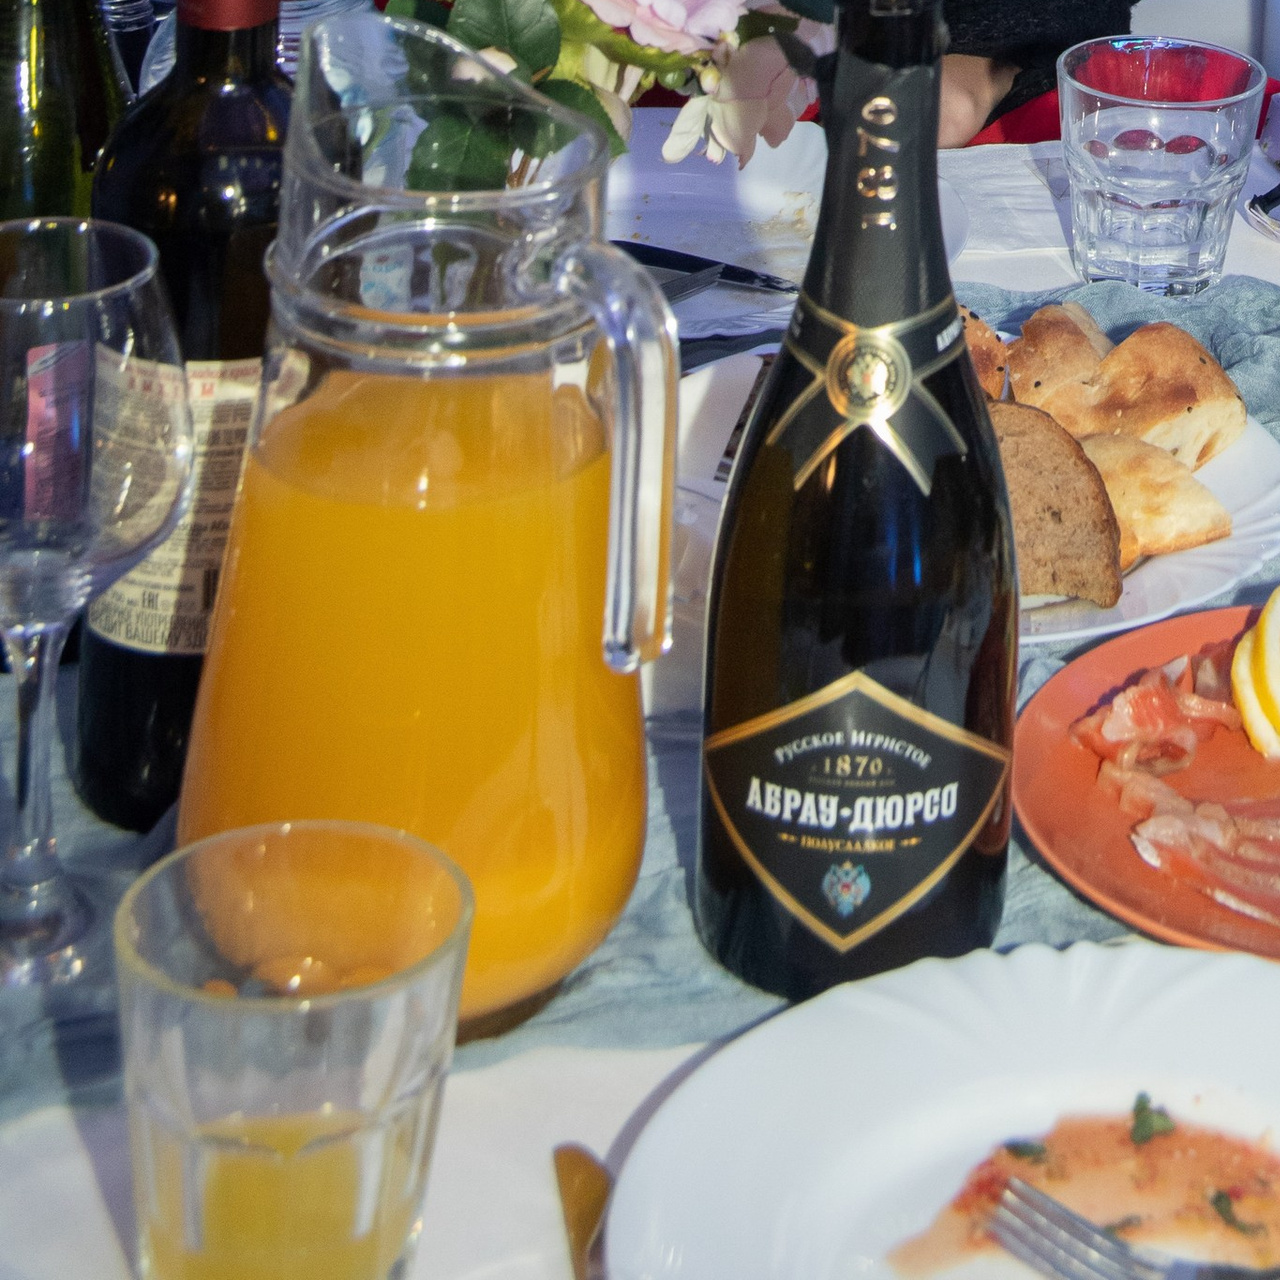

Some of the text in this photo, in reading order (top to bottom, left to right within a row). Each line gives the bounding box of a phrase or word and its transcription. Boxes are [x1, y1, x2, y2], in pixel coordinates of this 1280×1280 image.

[856, 96, 900, 230] 1870
[774, 729, 932, 770] РУССКОЕ ИГРИСТОЕ
[823, 754, 884, 778] 1870
